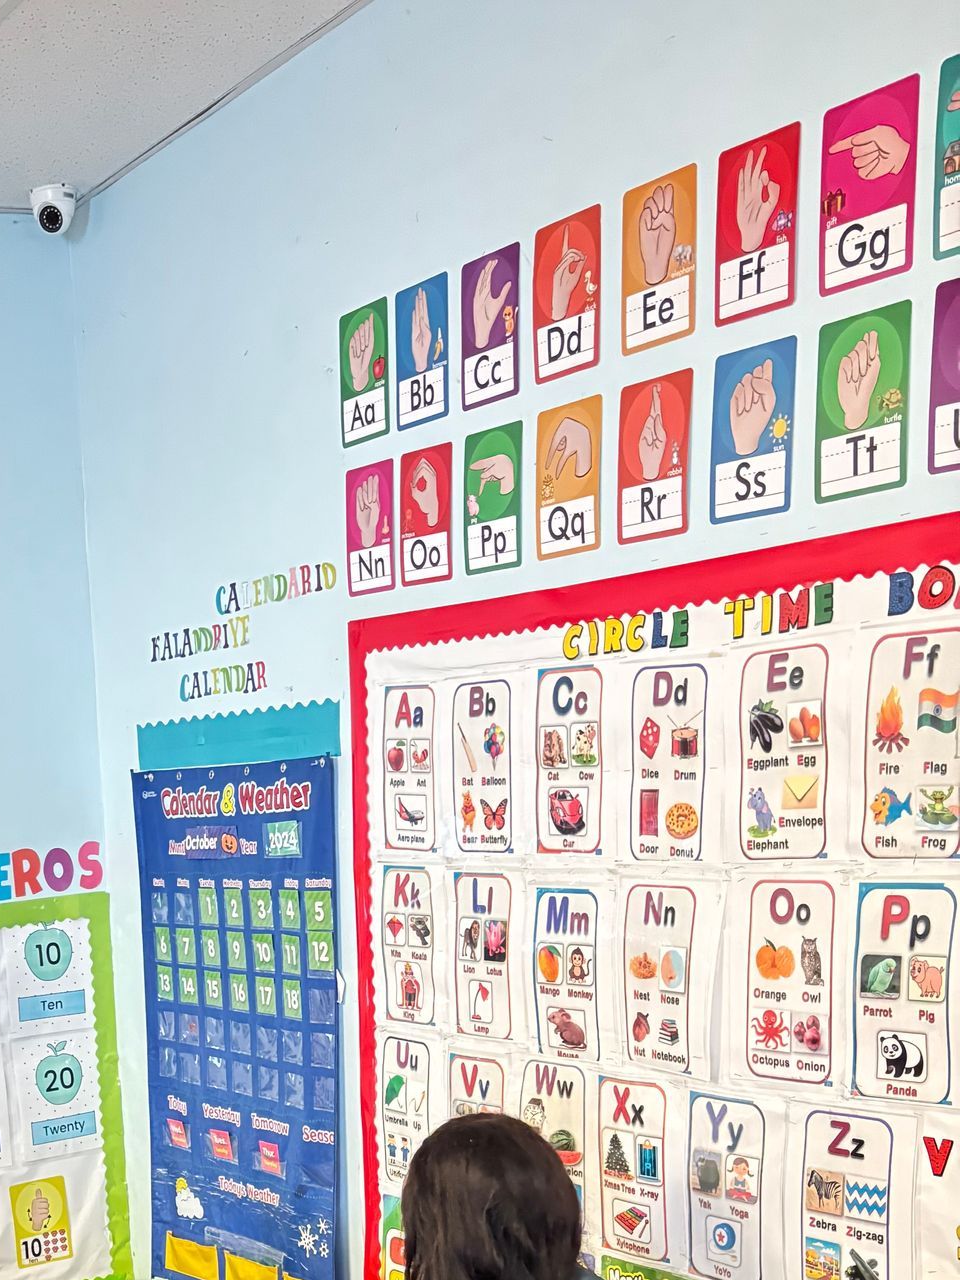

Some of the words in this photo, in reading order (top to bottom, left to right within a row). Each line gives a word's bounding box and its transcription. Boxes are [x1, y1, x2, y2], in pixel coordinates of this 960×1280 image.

[838, 224, 890, 270] Gg
[738, 250, 767, 300] Ff
[642, 291, 674, 331] Ee
[548, 316, 582, 362] Dd
[474, 355, 502, 389] Cc
[410, 374, 434, 411] Bb
[350, 400, 376, 431] Aa
[884, 413, 903, 424] turtle
[846, 434, 878, 477] Tt
[735, 461, 767, 501] Ss
[640, 486, 667, 523] Rr
[548, 506, 586, 543] Qq
[410, 540, 440, 570] Oo
[482, 525, 507, 563] Pp
[359, 552, 385, 581] Nn
[562, 610, 689, 661] CIRCLE
[724, 582, 834, 639] TIME
[150, 615, 250, 662] KALANDRIYE
[767, 653, 804, 691] Ee
[902, 637, 940, 679] Ff
[179, 661, 267, 702] CALENDAR
[552, 676, 588, 716] Cc
[652, 672, 688, 707] Dd
[395, 692, 424, 728] Aa
[469, 686, 496, 717] Bb
[547, 771, 559, 781] Cat
[579, 771, 595, 781] Cow
[641, 768, 659, 780] Dice
[674, 770, 697, 781] Drum
[747, 756, 789, 771] Eggplant
[797, 755, 817, 767] Egg
[879, 763, 900, 774] Fire
[923, 761, 947, 775] Flag
[462, 777, 474, 786] Bat
[481, 776, 506, 786] Balloon
[161, 787, 219, 818] Calendar
[221, 784, 235, 816] &
[239, 778, 312, 815] Weather
[778, 816, 823, 830] Envelope
[186, 834, 218, 850] October
[269, 832, 298, 850] 2024
[639, 843, 659, 855] Door
[747, 838, 789, 852] Elephant
[875, 836, 897, 848] Fish
[921, 836, 946, 850] Frog
[314, 901, 324, 922] 5
[546, 896, 589, 936] Mm
[644, 891, 675, 927] Nn
[770, 888, 811, 925] Oo
[881, 895, 930, 948] Pp
[35, 942, 61, 967] 10
[256, 943, 271, 962] 10
[313, 941, 329, 963] 12
[40, 999, 63, 1012] Ten
[568, 989, 593, 1001] Monkey
[753, 988, 787, 1002] Orange
[802, 991, 821, 1003] Owl
[863, 1005, 892, 1018] Parrot
[918, 1010, 935, 1023] Pig
[651, 1049, 686, 1064] Notebook
[752, 1054, 790, 1068] Octopus
[796, 1060, 826, 1073] Onion
[44, 1067, 75, 1092] 20
[886, 1084, 917, 1098] Panda
[202, 1103, 241, 1127] Yesterday
[612, 1086, 644, 1126] Xx
[42, 1119, 86, 1138] Twenty
[251, 1113, 289, 1136] Tomorrow
[707, 1101, 744, 1152] Yy
[828, 1120, 865, 1160] Zz
[809, 1217, 837, 1232] Zebra
[846, 1226, 884, 1244] Zig-zag
[22, 1238, 42, 1259] 10
